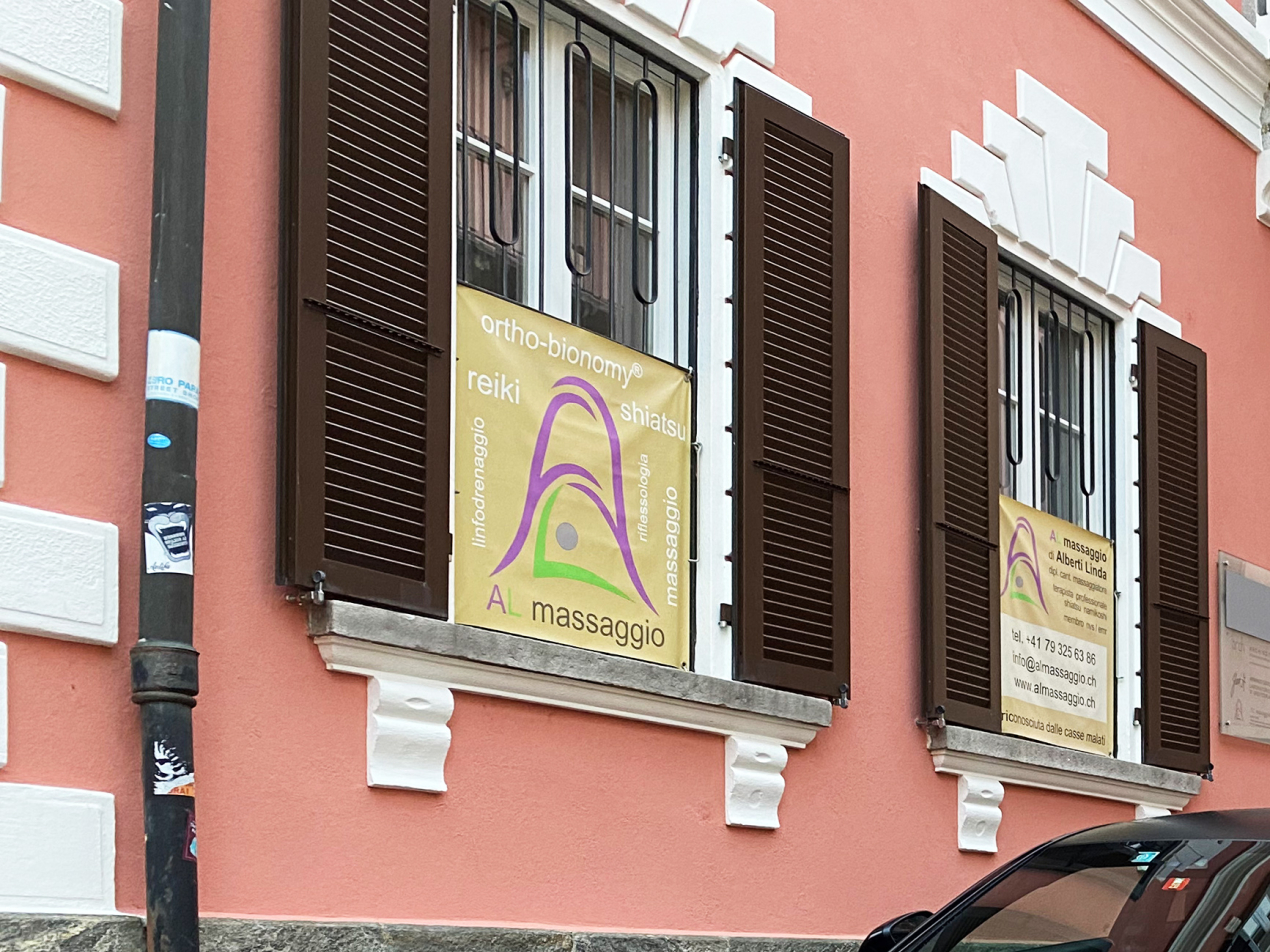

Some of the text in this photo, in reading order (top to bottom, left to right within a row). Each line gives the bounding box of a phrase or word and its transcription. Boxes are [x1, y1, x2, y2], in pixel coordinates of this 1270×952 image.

[468, 368, 520, 405] reiki
[621, 401, 686, 442] shiatsu
[472, 416, 488, 548] linfodrenaggio
[638, 454, 649, 542] riflessologia
[666, 486, 681, 606] massaggio
[1050, 529, 1107, 562] AL massaggio
[1048, 550, 1107, 580] di Alberti Linda
[486, 584, 665, 650] AL massaggio
[1012, 628, 1096, 666] tel. +41 79 325 63 86
[1012, 650, 1097, 687] info@almassaggio.ch
[1014, 677, 1096, 708] www.almassaggio.ch
[1002, 710, 1106, 746] riconosciuta dalle casse malati
